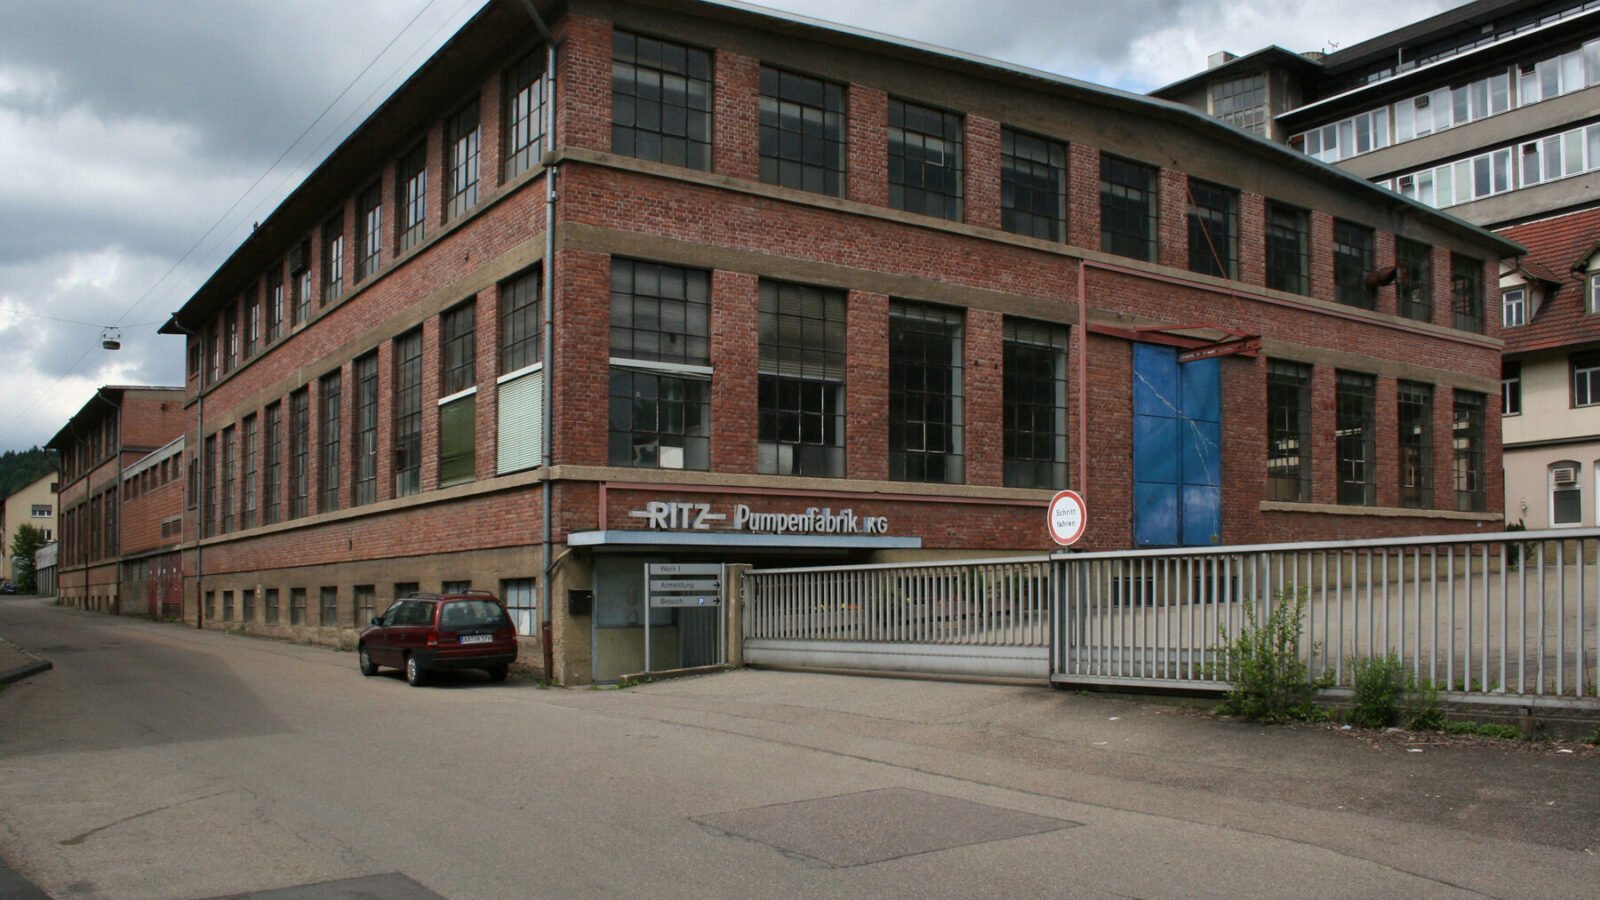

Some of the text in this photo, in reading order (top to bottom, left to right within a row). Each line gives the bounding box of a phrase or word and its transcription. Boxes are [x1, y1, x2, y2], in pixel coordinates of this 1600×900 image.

[1056, 508, 1076, 517] Schritt
[648, 501, 888, 534] RITZ Pumpenfabrik KG
[1057, 520, 1076, 528] fahren
